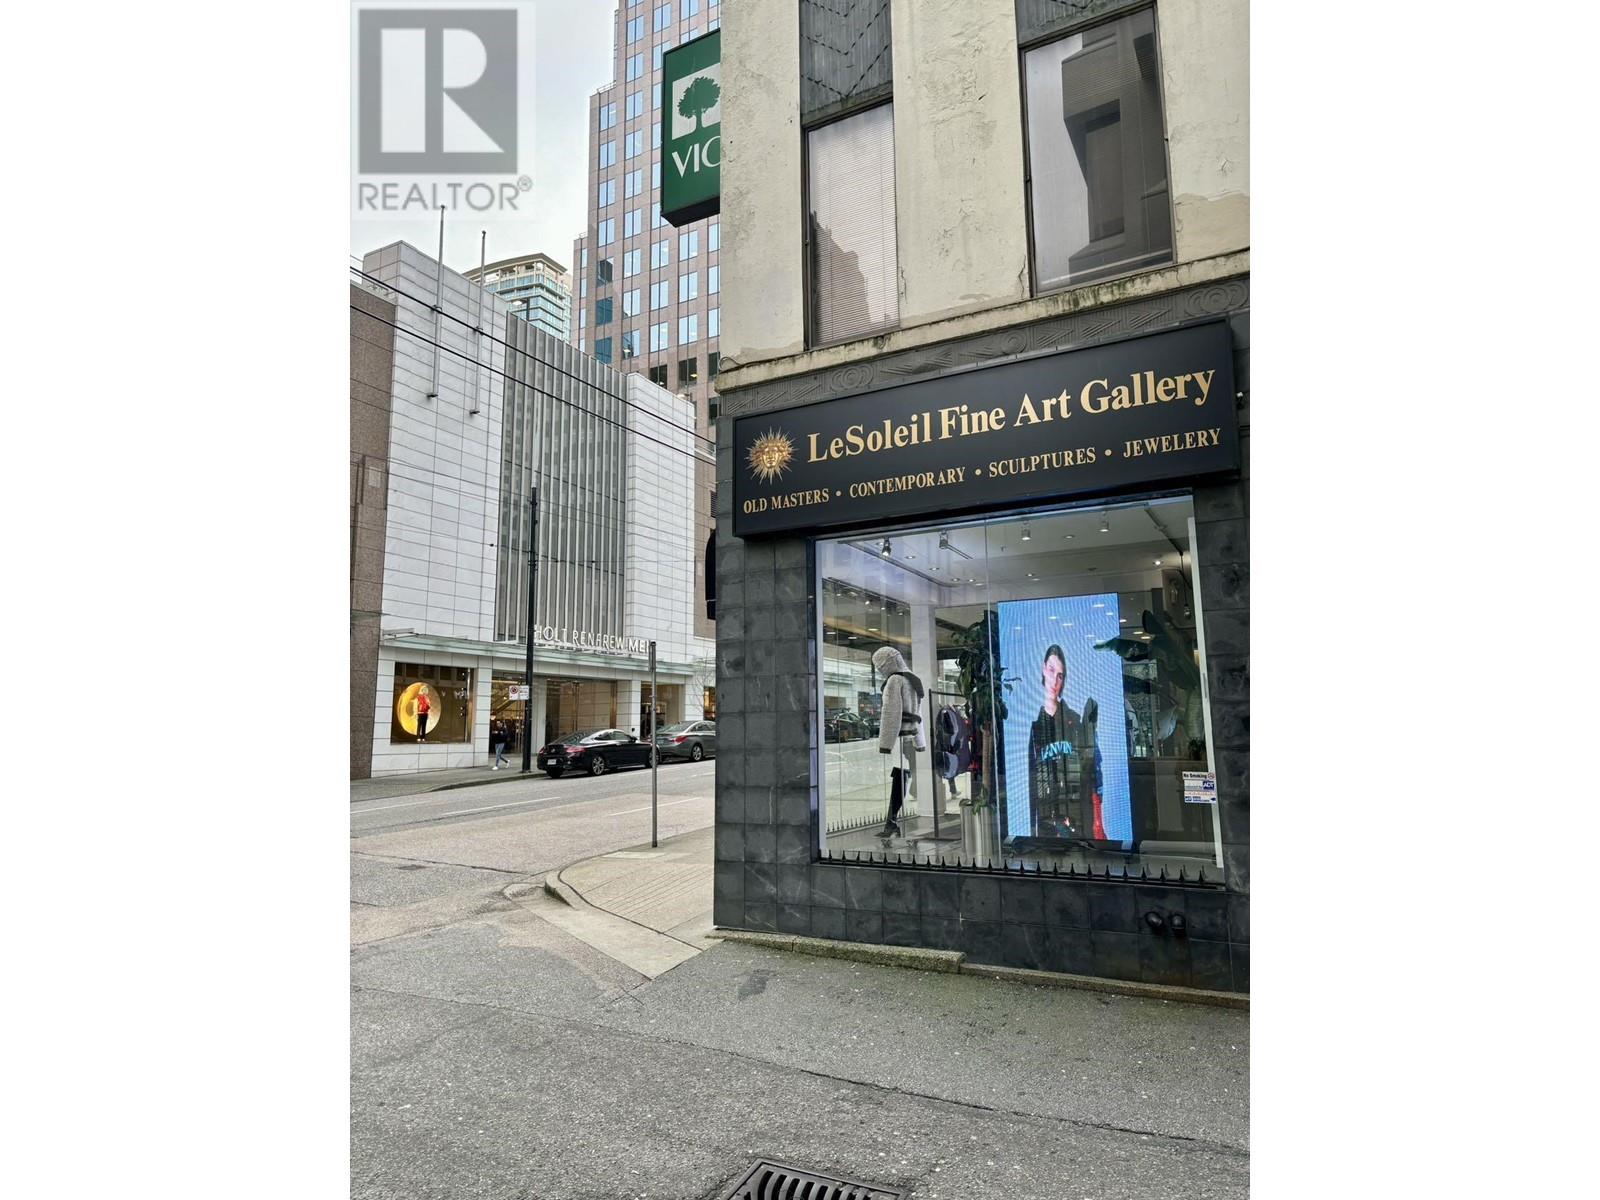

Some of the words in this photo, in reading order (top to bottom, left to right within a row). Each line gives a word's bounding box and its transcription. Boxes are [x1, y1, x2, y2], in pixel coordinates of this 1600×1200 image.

[807, 411, 932, 463] LeSoleil
[938, 404, 1006, 440] Fine
[1013, 388, 1072, 427] Art
[1080, 369, 1216, 415] Gallery
[743, 498, 768, 515] OLD
[771, 488, 830, 511] MASTERS
[849, 466, 966, 499] CONTEMPORARY
[988, 446, 1097, 479] SCULPTURES
[1123, 427, 1221, 459] JEWELERY
[572, 628, 625, 652] RENFREW
